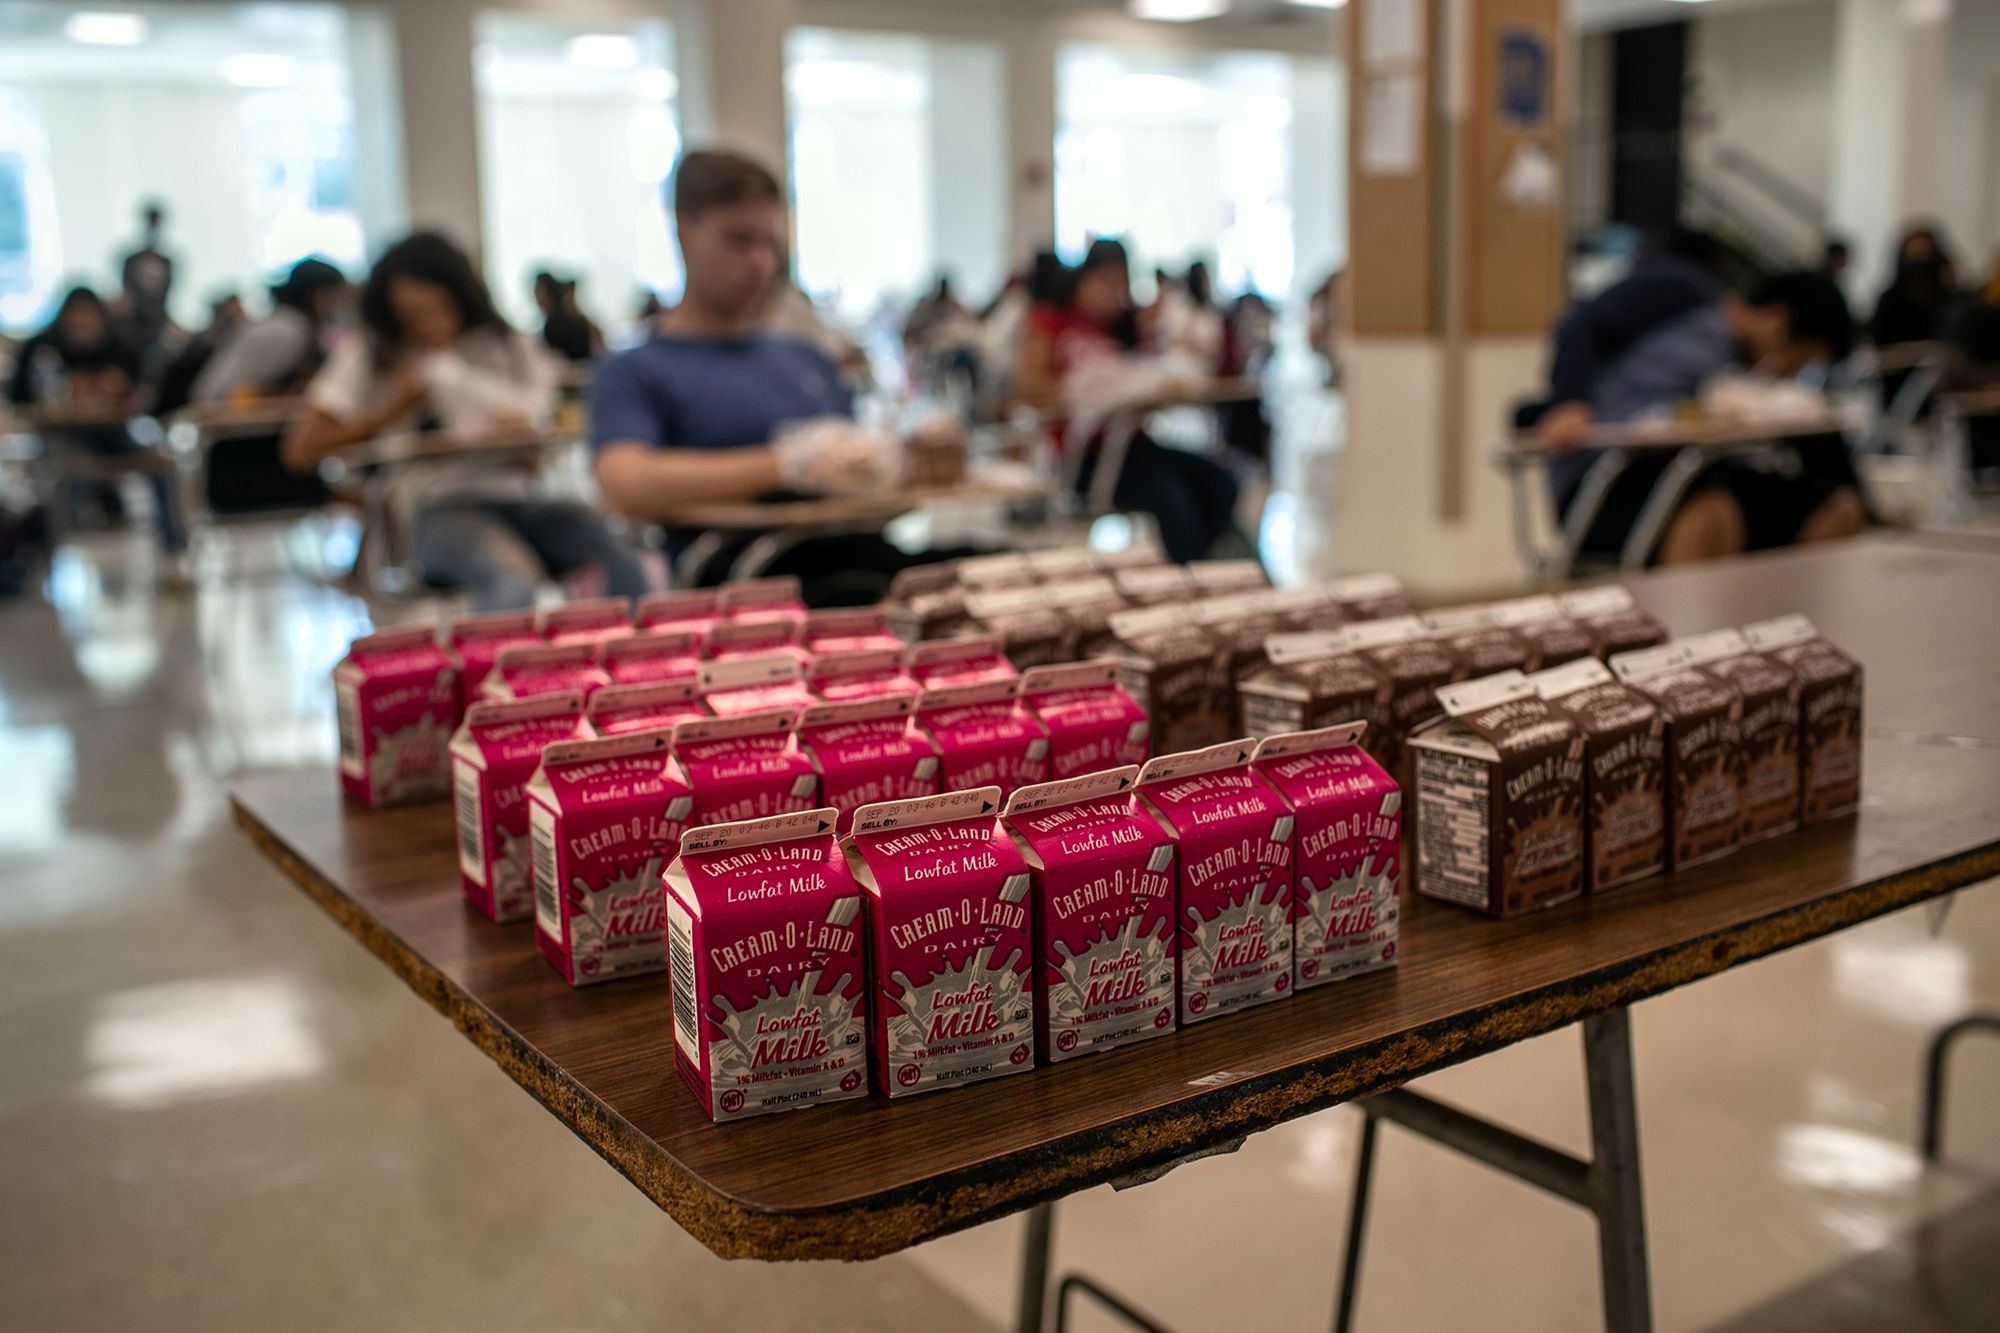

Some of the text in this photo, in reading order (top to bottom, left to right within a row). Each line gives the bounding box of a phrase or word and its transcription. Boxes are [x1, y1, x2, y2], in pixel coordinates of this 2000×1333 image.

[582, 778, 664, 804] Lowfat Milk
[1305, 773, 1375, 799] Lowfat Milk
[866, 808, 883, 820] SEP
[888, 806, 899, 816] 20
[950, 796, 961, 805] 42
[1014, 800, 1032, 811] SELL
[1192, 796, 1267, 825] Lowfat Milk
[695, 830, 713, 841] SEP
[719, 828, 732, 838] 20
[786, 817, 798, 827] 42
[802, 814, 818, 825] 040
[861, 818, 898, 830] SELL BY:
[1062, 817, 1116, 832] DAIRY
[689, 838, 728, 850] SELL BY:
[908, 842, 972, 857] DAIRY
[1061, 825, 1144, 855] Lowfat Milk
[735, 863, 801, 878] DAIRY
[904, 852, 999, 881] Lowfat Milk
[727, 873, 827, 903] Lowfat Milk
[1213, 870, 1272, 890] DAIRY
[1083, 902, 1150, 923] DAIRY
[1330, 887, 1373, 912] Lowfat
[1217, 914, 1264, 942] Lowfat
[1325, 906, 1376, 942] Milk
[924, 933, 1003, 954] DAIRY
[1213, 935, 1269, 974] Milk
[747, 957, 831, 977] DAIRY
[1089, 948, 1142, 977] Lowfat
[931, 981, 994, 1011] Lowfat
[1083, 969, 1147, 1010] Milk
[756, 1006, 821, 1035] Lowfat
[927, 1002, 1001, 1044] Milk
[751, 1028, 829, 1070] Milk
[913, 1050, 926, 1060] 1%
[927, 1045, 957, 1058] Milkfat
[962, 1038, 993, 1052] Vitamin
[736, 1058, 845, 1086] 1% Milkfat Vitamin A & D
[762, 1096, 776, 1106] Half
[777, 1094, 791, 1103] Pint
